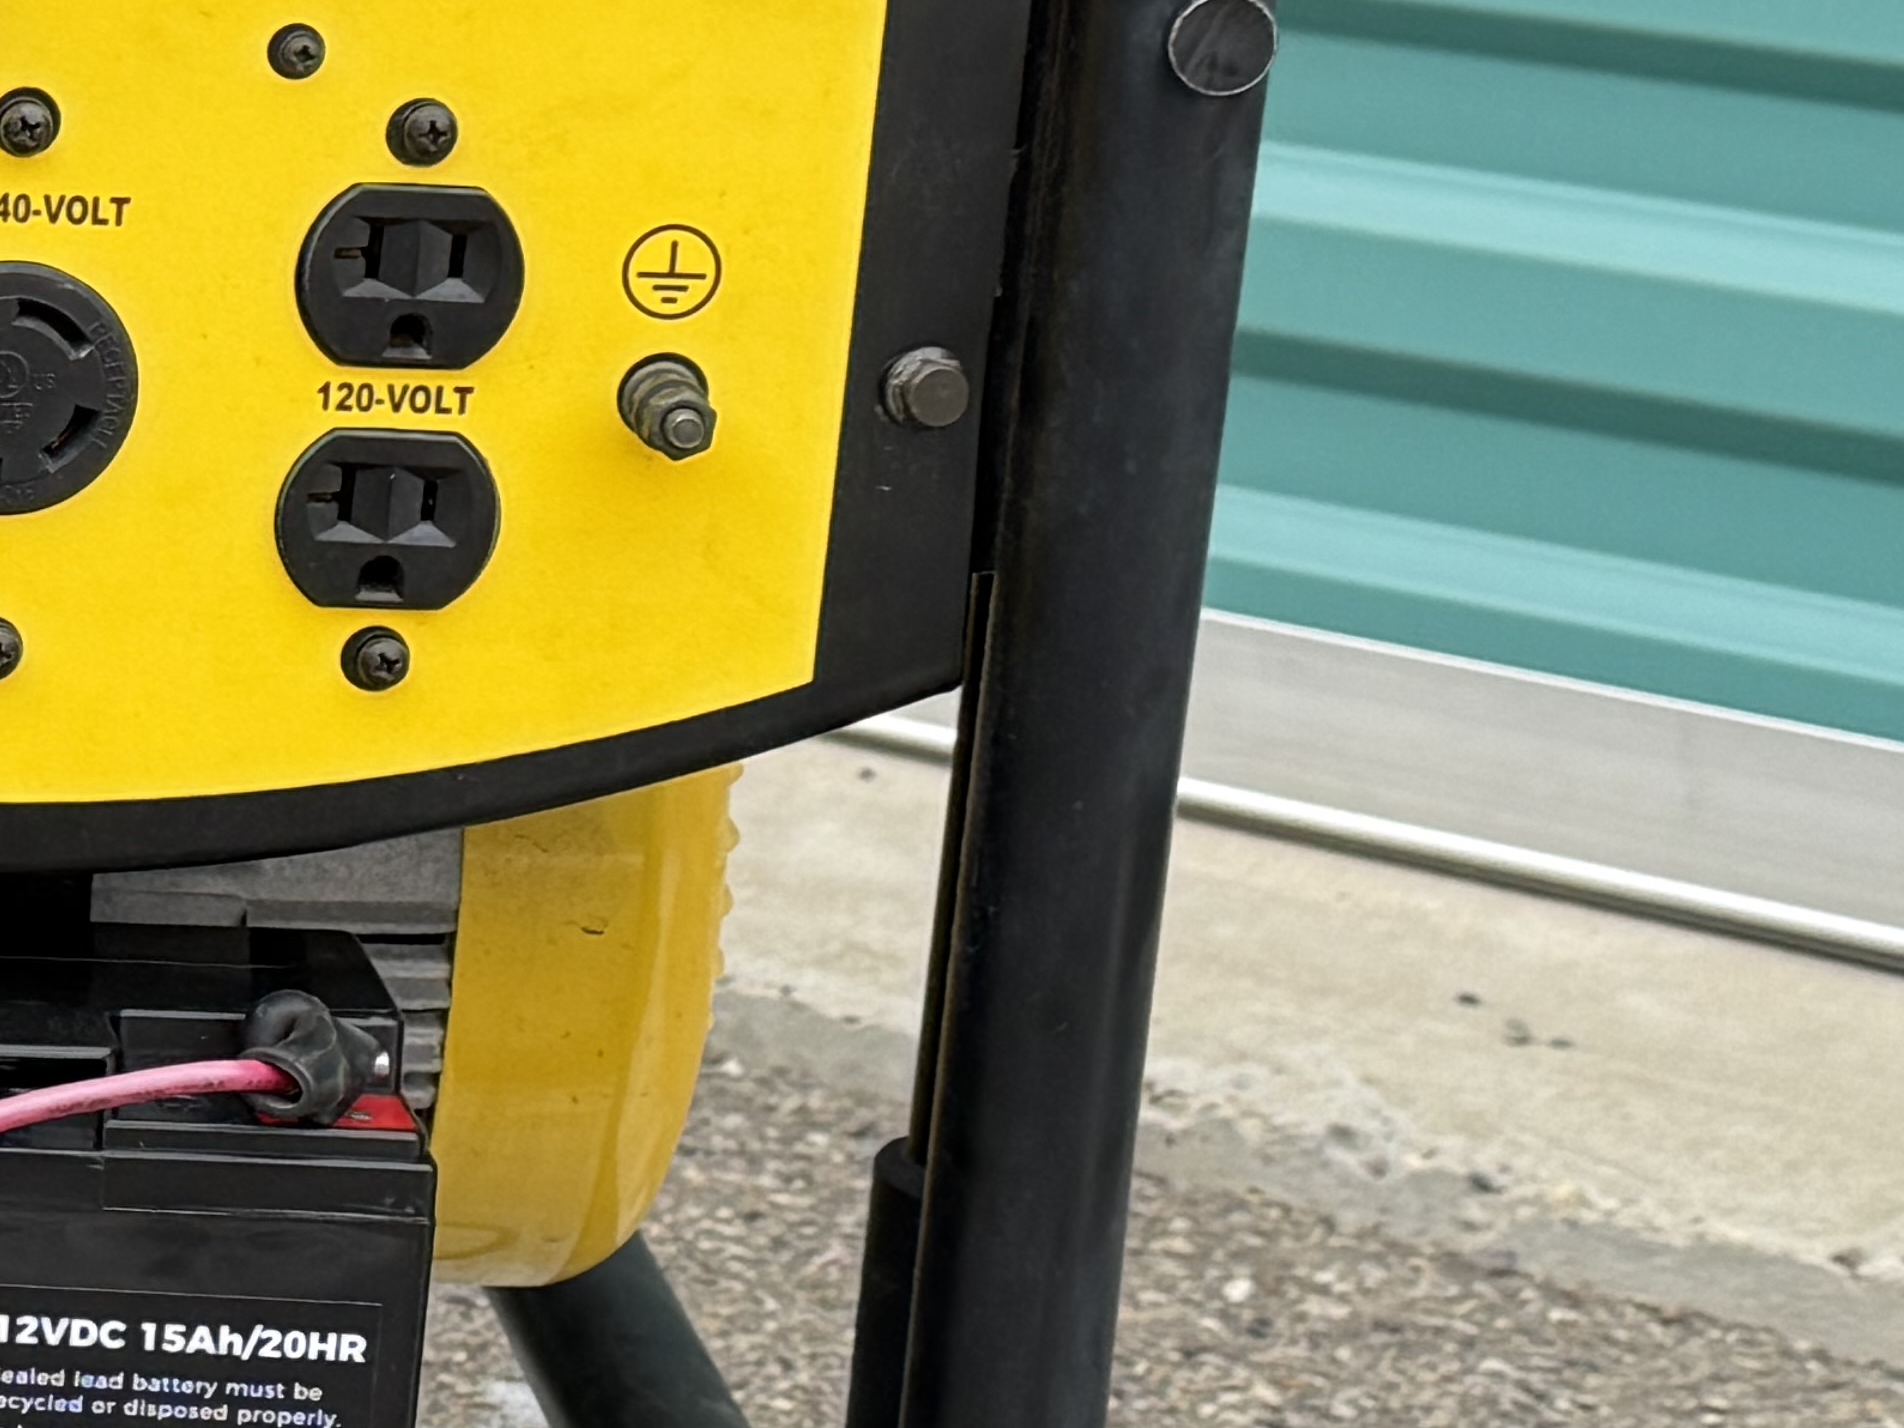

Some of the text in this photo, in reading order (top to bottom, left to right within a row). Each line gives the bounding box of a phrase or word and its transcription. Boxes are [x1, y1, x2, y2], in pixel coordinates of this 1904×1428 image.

[317, 381, 474, 415] 120-VOLT
[141, 1322, 367, 1363] 15Ah/20HR
[73, 1370, 124, 1390] lead
[132, 1373, 217, 1399] battery
[225, 1382, 285, 1399] must
[293, 1382, 322, 1401] be
[91, 1400, 116, 1414] or
[123, 1399, 228, 1421] disposed
